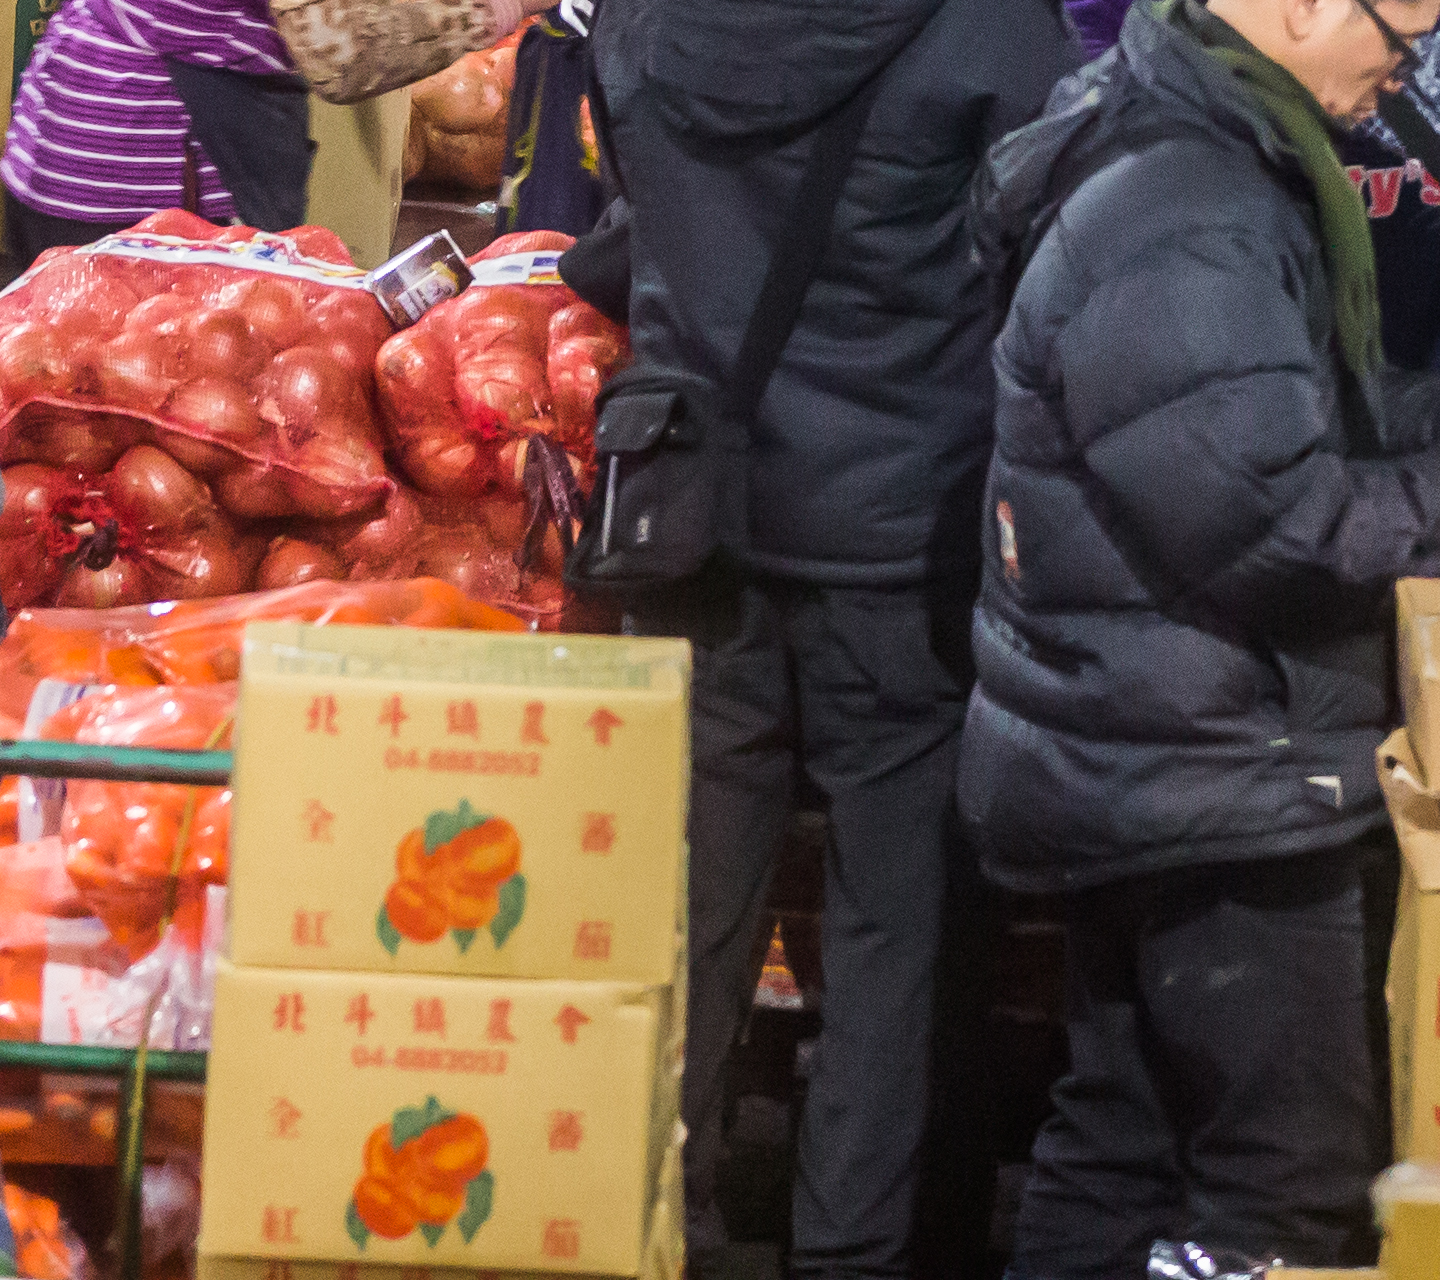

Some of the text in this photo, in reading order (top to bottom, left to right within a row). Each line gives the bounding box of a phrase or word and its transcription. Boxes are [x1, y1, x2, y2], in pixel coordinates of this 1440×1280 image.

[302, 693, 628, 747] 北斗鎮農會
[271, 991, 593, 1043] 北斗鎮農會
